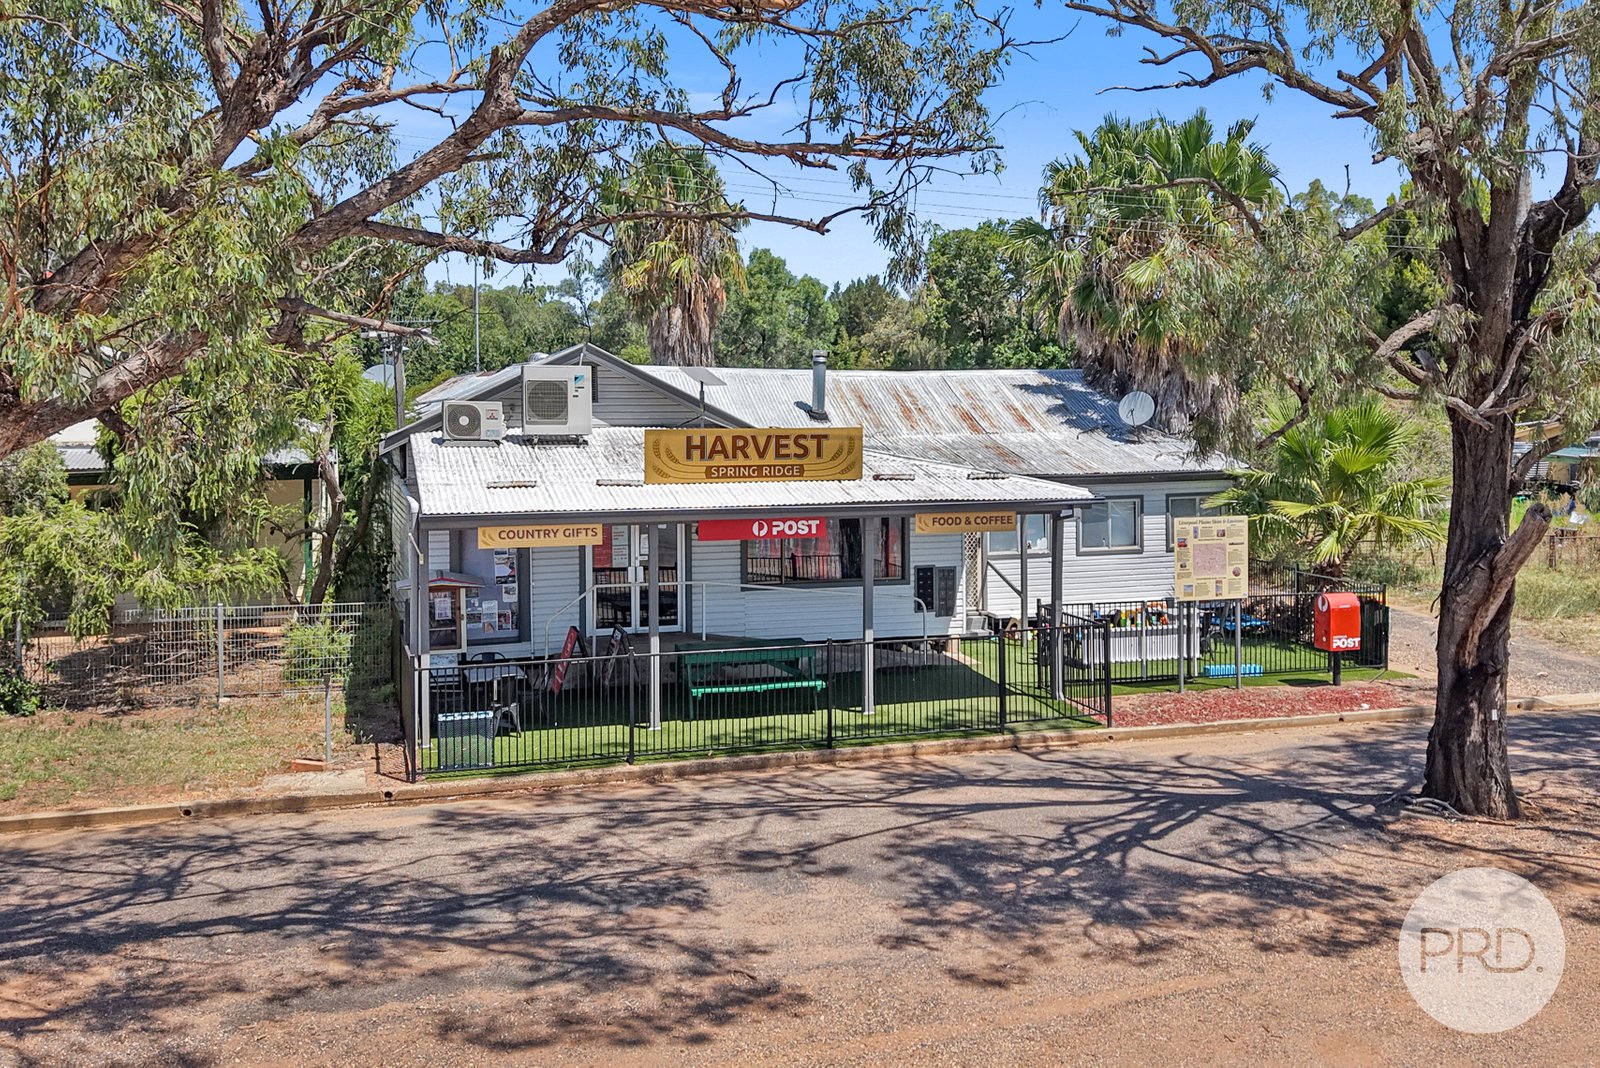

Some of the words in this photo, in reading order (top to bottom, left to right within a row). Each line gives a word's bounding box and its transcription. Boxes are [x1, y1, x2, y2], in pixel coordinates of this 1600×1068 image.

[686, 434, 829, 461] HARVEST
[711, 466, 758, 477] SPRING
[763, 465, 800, 476] RIDGE
[932, 516, 961, 526] FOOD
[964, 517, 972, 525] &
[974, 515, 1013, 525] COFFEE
[498, 528, 559, 540] COUNTRY
[563, 527, 598, 538] GIFTS
[771, 520, 820, 536] POST
[1332, 638, 1361, 648] POST
